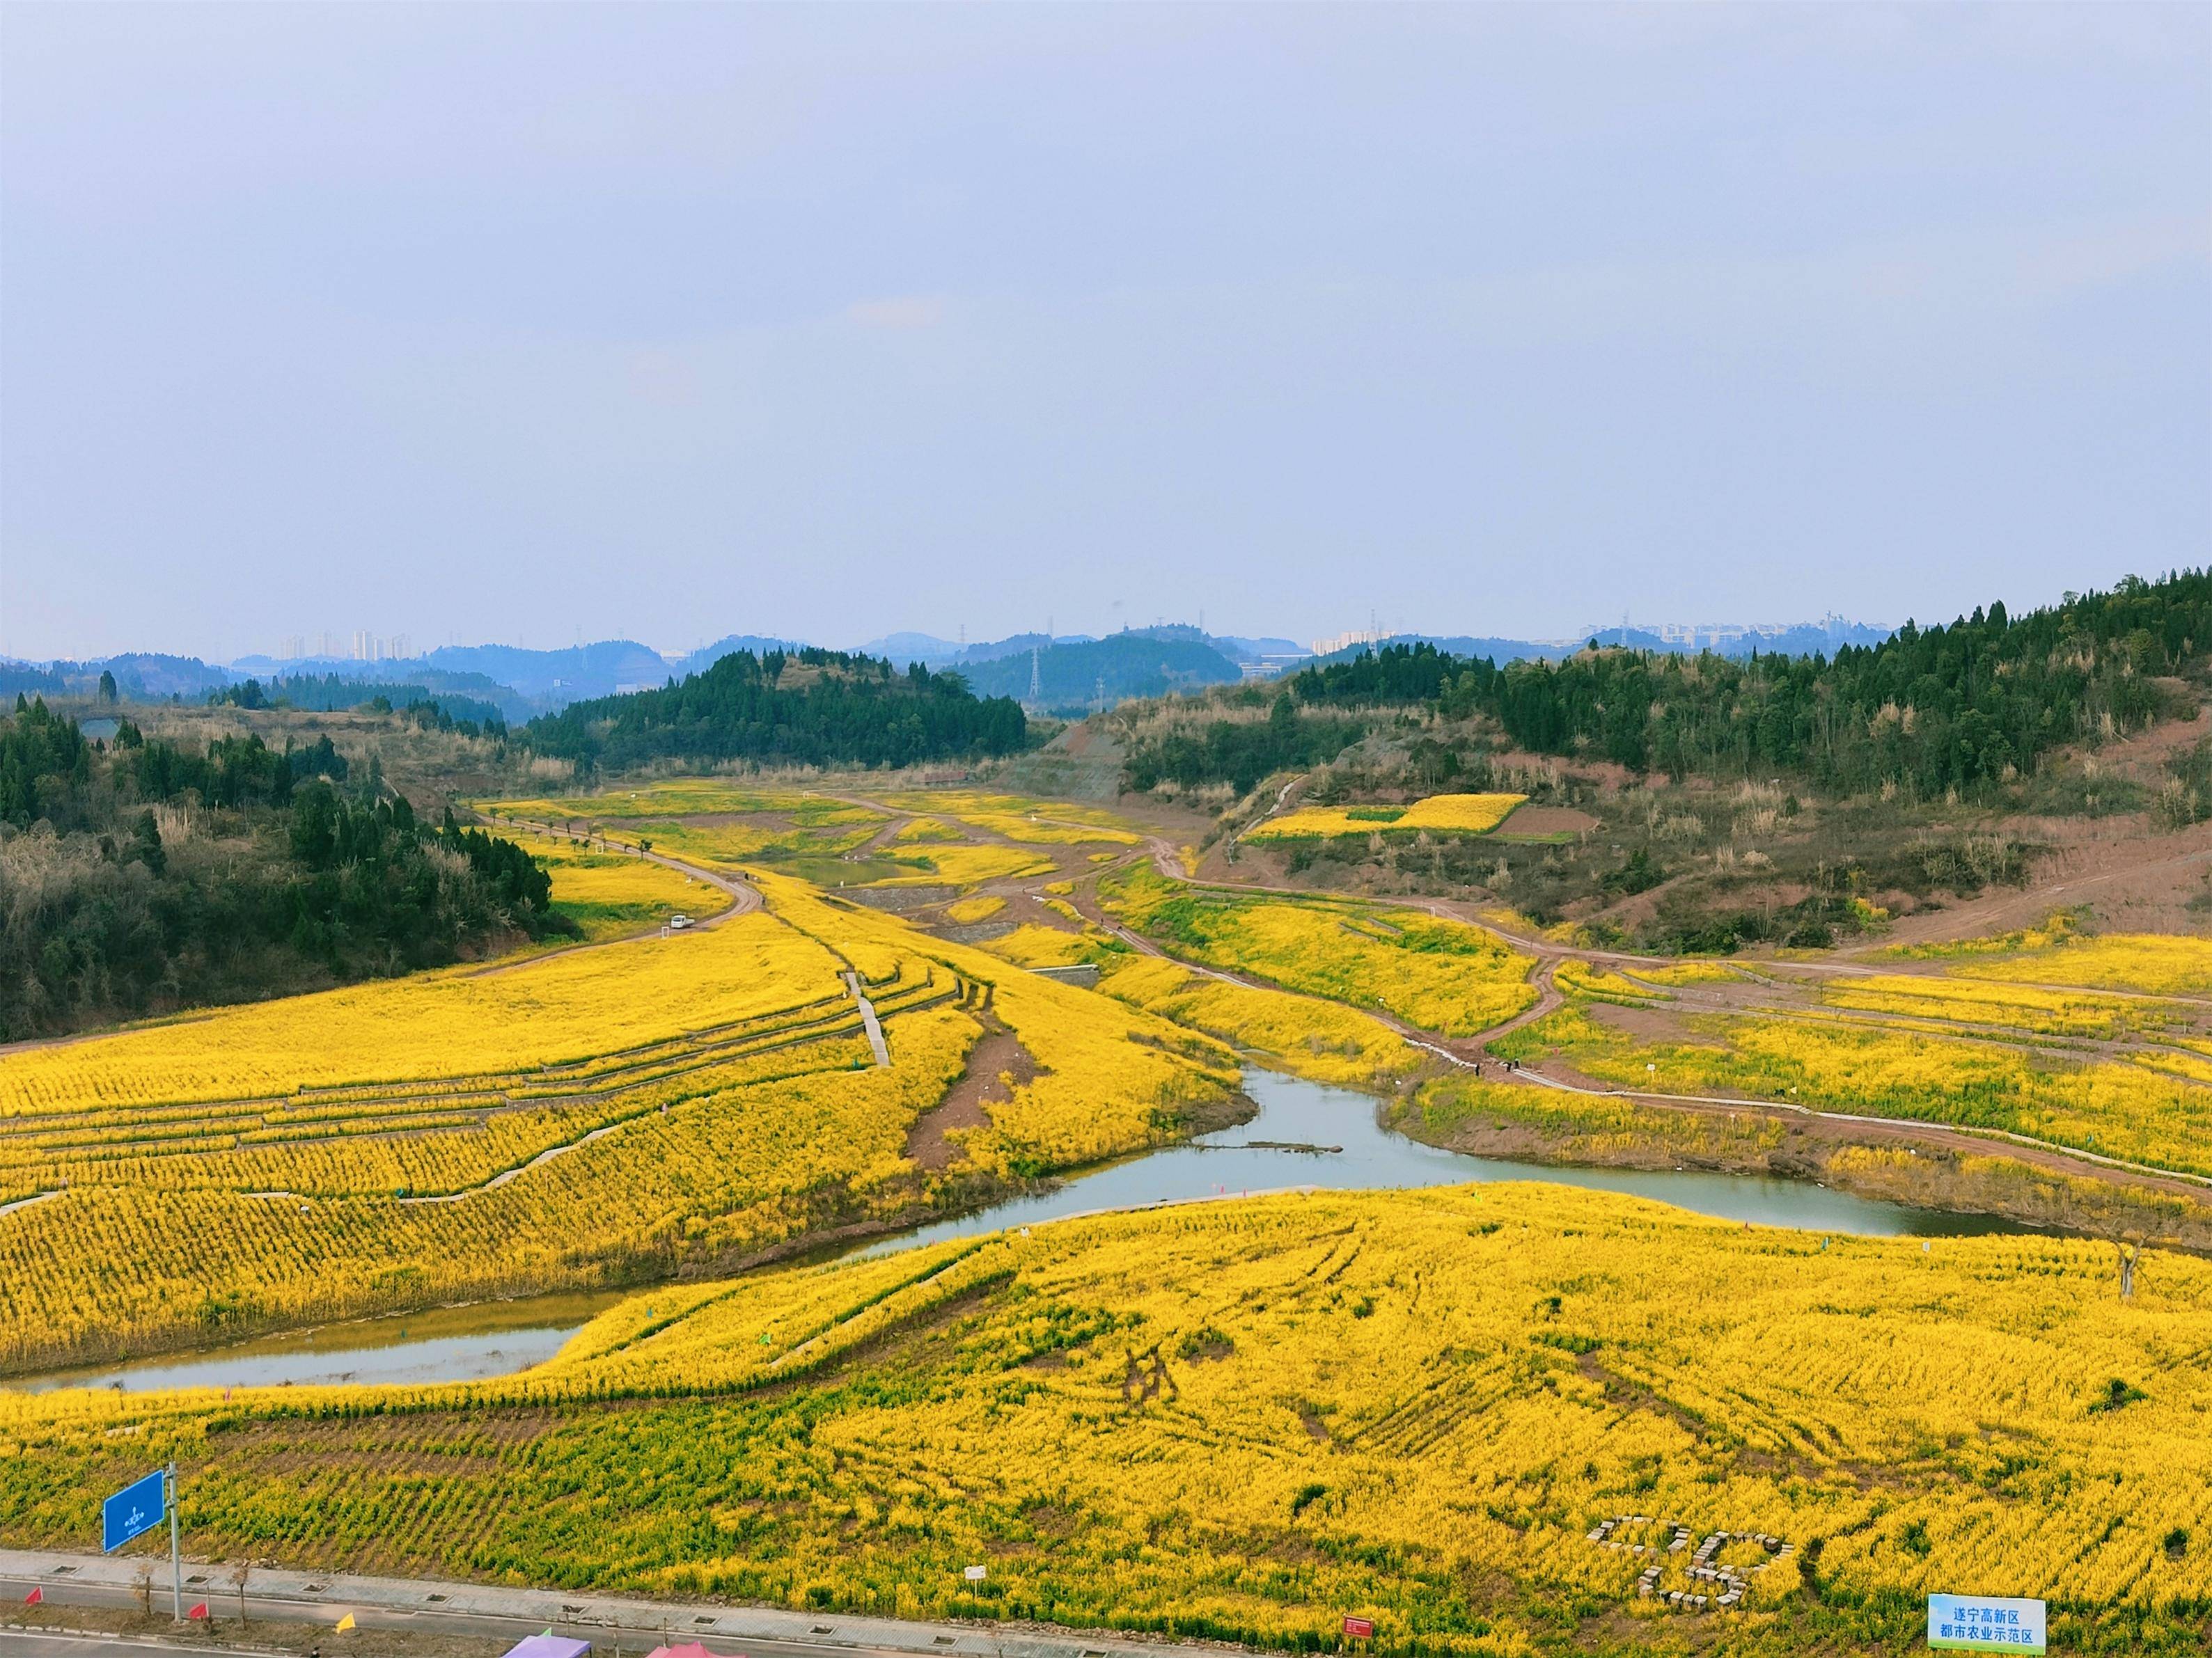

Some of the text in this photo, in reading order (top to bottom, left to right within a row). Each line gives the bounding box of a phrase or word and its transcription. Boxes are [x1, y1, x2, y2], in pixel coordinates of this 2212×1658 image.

[1954, 1606, 2019, 1625] 遂宁高新区
[1940, 1623, 2033, 1643] 都市农业示范区
